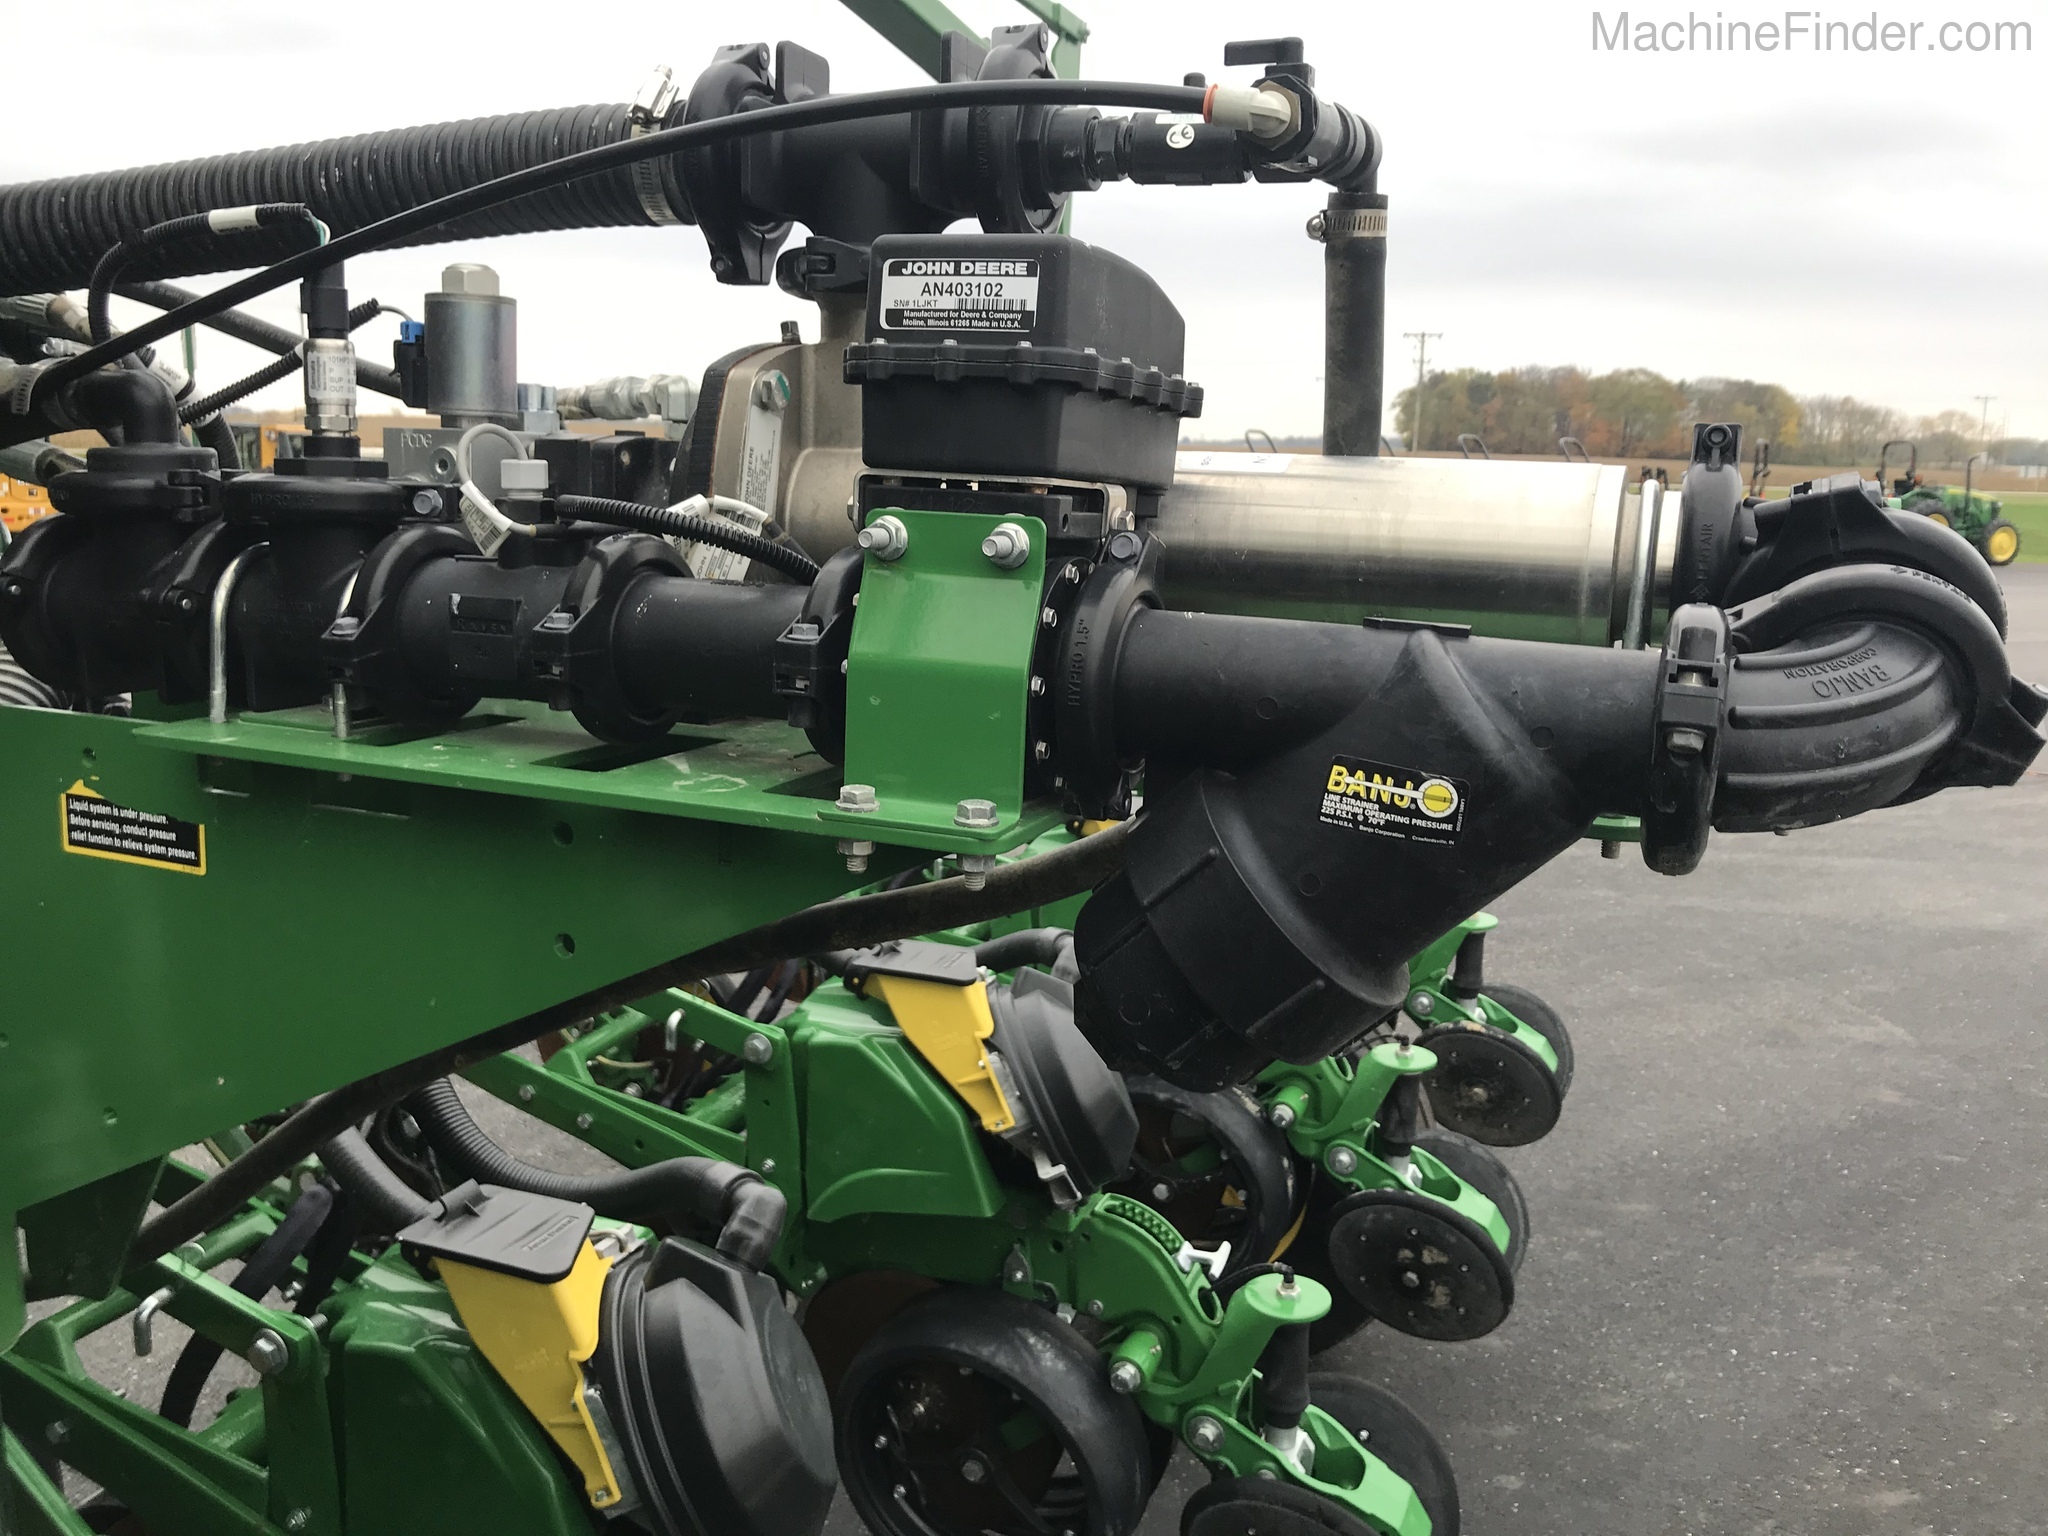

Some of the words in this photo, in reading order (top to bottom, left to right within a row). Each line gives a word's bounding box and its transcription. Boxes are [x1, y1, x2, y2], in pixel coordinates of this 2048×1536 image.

[901, 262, 955, 275] JOHN
[960, 262, 1028, 275] DEERE
[893, 299, 910, 307] SN#
[912, 299, 938, 307] 1LJKT
[920, 282, 1004, 297] AN403102
[902, 319, 926, 327] Moline,
[927, 319, 949, 327] Illinois
[971, 319, 990, 327] Made
[999, 320, 1021, 328] U.S.A.
[903, 310, 948, 318] Manufactured
[949, 310, 959, 318] for
[960, 310, 980, 318] Deere
[988, 311, 1022, 320] Company
[746, 446, 755, 477] DEERE
[1696, 523, 1714, 579] PENTAIR
[1911, 569, 1972, 604] PENTAIR
[1074, 619, 1090, 647] 1.5"
[1783, 647, 1878, 680] CORPORATION
[1067, 652, 1084, 706] HYPRO
[1811, 663, 1892, 699] BANJO
[69, 798, 89, 811] Liquid
[89, 803, 112, 815] system
[112, 805, 118, 815] is
[119, 807, 138, 819] under
[139, 811, 169, 824] pressure.
[1320, 805, 1335, 815] 225
[1335, 809, 1354, 820] P.S.I.
[1367, 815, 1386, 826] 70°F
[1322, 799, 1364, 815] MAXIMUM
[1364, 808, 1410, 824] OPERATING
[1411, 819, 1454, 831] PRESSURE
[1324, 792, 1341, 802] LINE
[1341, 796, 1380, 811] STRAINER
[70, 813, 91, 827] Before
[91, 818, 122, 834] servicing,
[122, 824, 148, 836] conduct
[149, 828, 176, 841] pressure
[1319, 815, 1333, 823] Made
[1358, 824, 1374, 834] Banjo
[1374, 827, 1406, 839] Corporation
[71, 830, 87, 841] relief
[88, 832, 113, 846] function
[114, 836, 122, 846] to
[122, 838, 143, 851] relieve
[144, 842, 167, 855] system
[168, 846, 198, 860] pressure.
